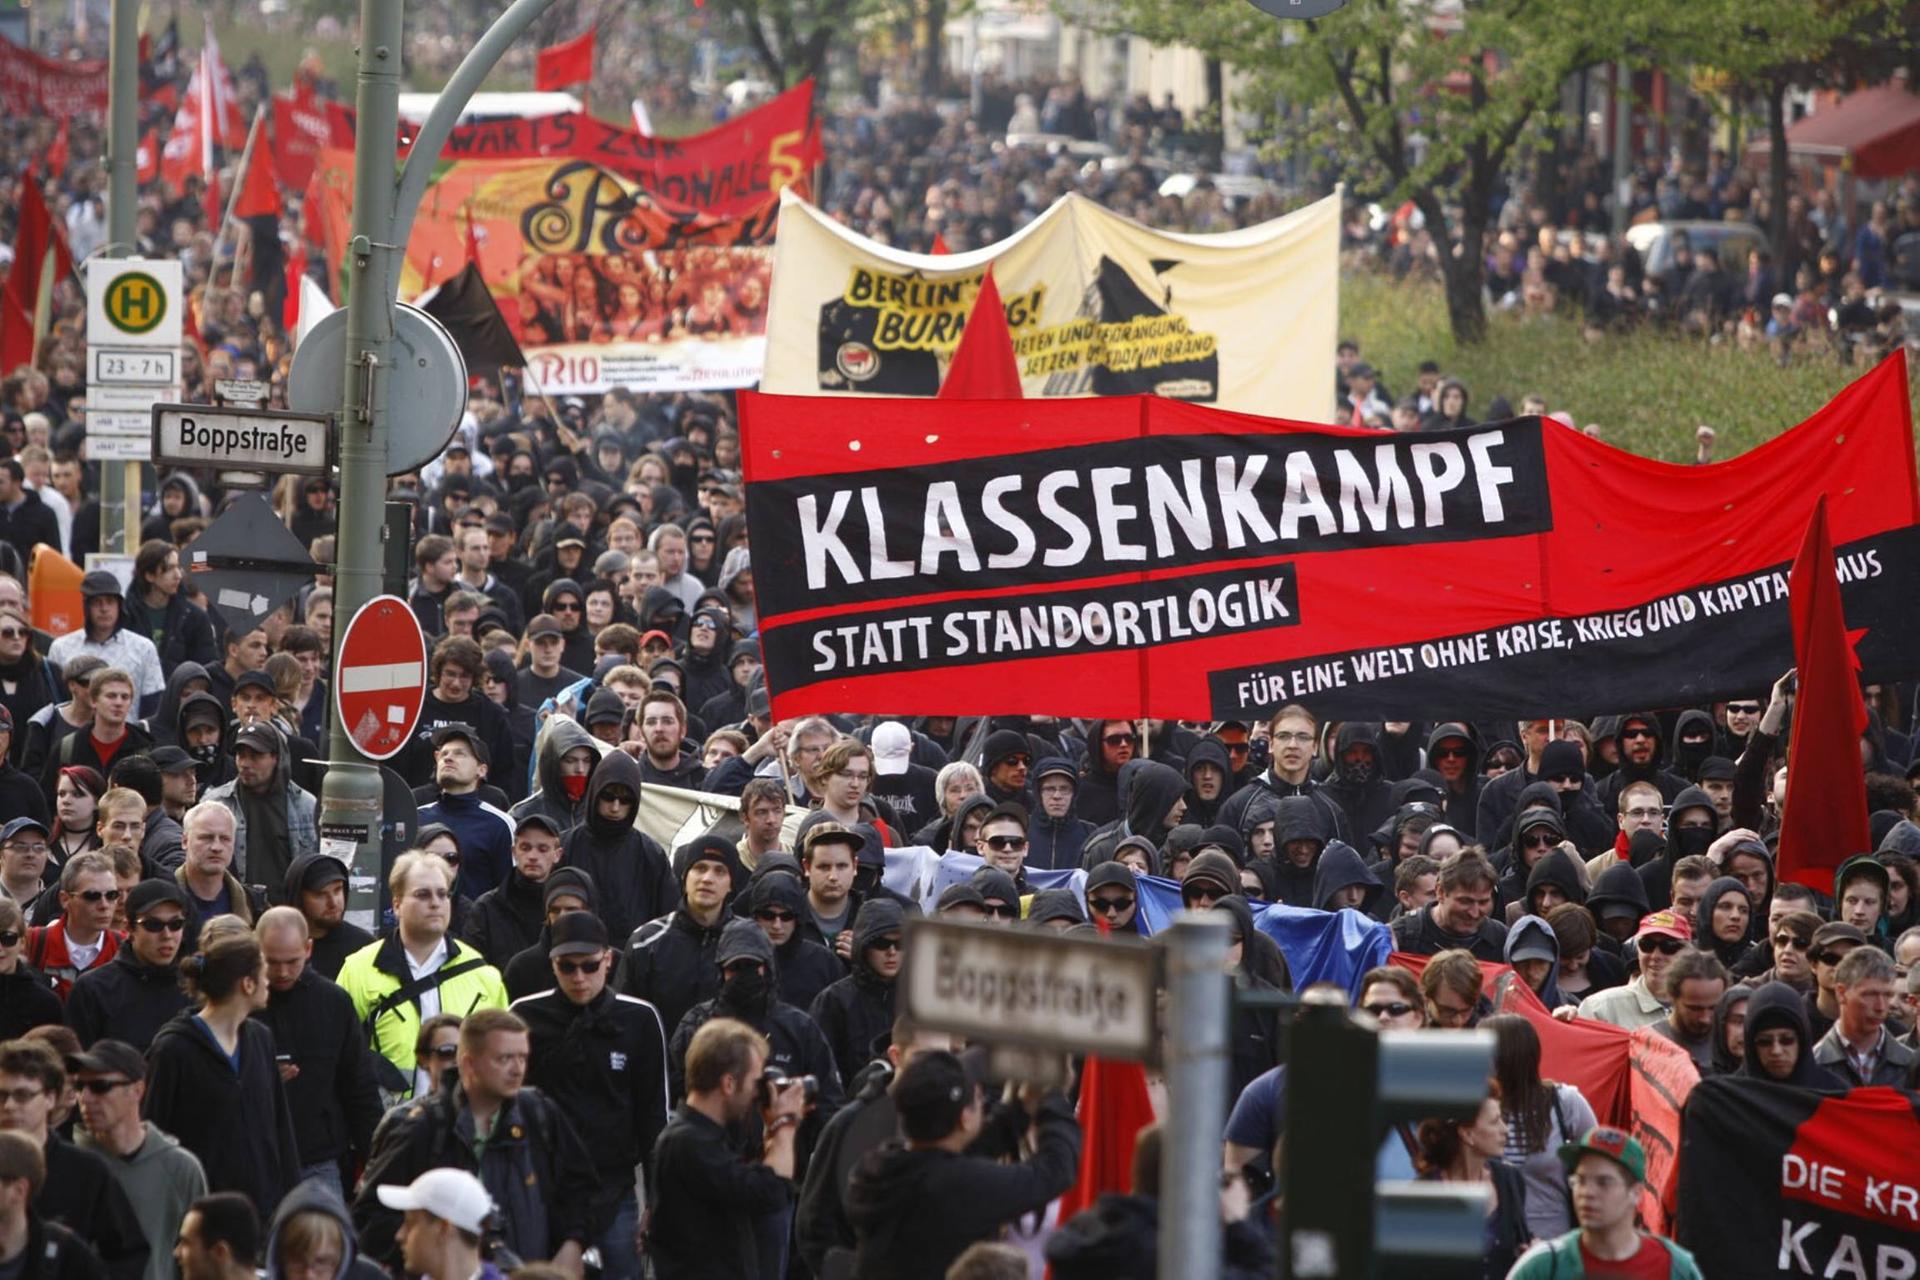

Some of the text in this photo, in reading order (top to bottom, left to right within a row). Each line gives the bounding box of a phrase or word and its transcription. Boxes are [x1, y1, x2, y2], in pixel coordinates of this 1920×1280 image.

[769, 130, 801, 192] 5
[107, 360, 125, 374] 23
[142, 360, 150, 375] 7
[155, 360, 163, 374] h
[180, 418, 307, 458] Boppstraße
[797, 430, 1514, 590] KLASSENKAMPF
[812, 577, 1290, 672] STATT STANDORTLOGIK
[1238, 549, 1883, 708] FÜR EINE WELT OHNE KRISE, KRIEG UND KAPITAMUS
[1783, 1153, 1846, 1200] DIE
